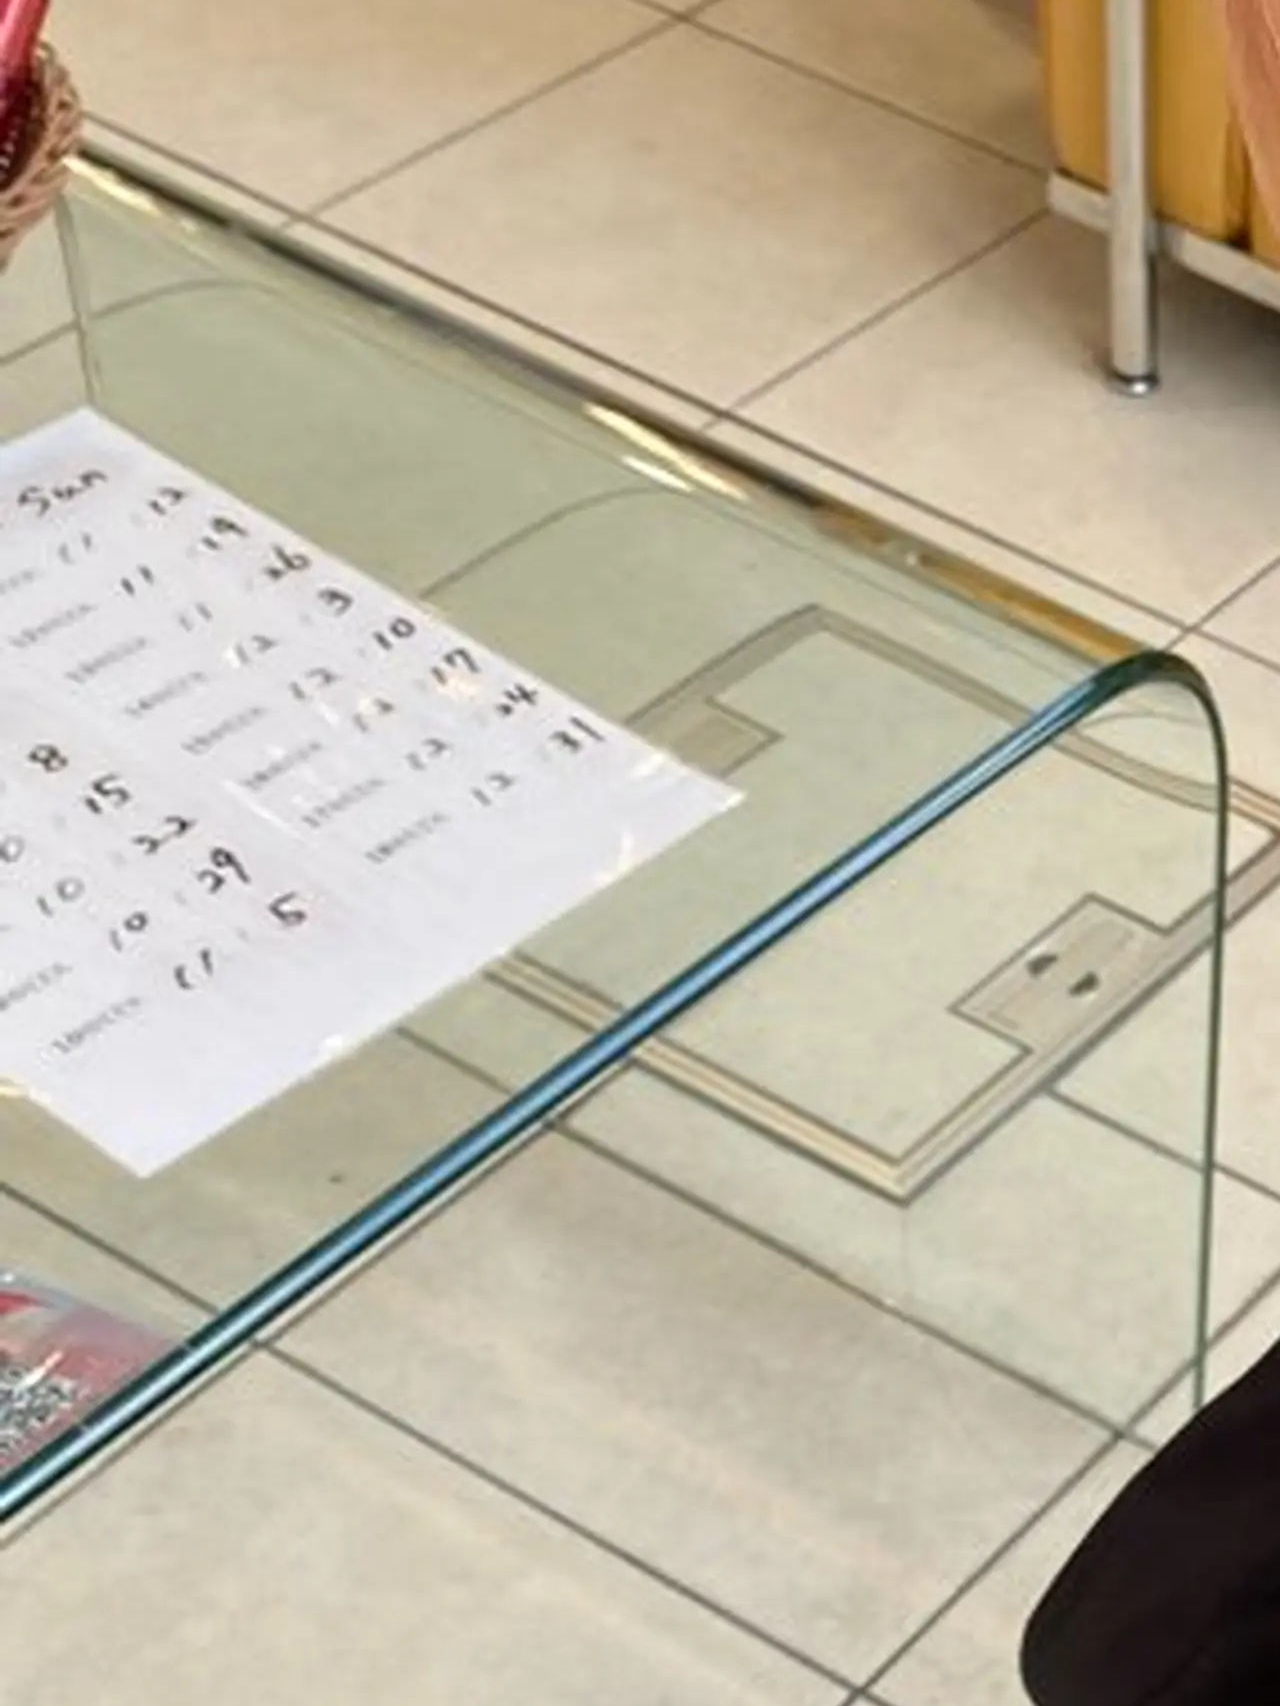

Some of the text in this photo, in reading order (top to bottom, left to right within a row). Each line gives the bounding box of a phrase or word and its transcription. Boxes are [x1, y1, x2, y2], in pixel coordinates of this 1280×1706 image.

[17, 469, 108, 518] Sun
[372, 617, 417, 650] 10
[27, 744, 68, 773] 8
[84, 773, 130, 814] 15
[198, 846, 250, 893] 29
[269, 891, 307, 926] 5
